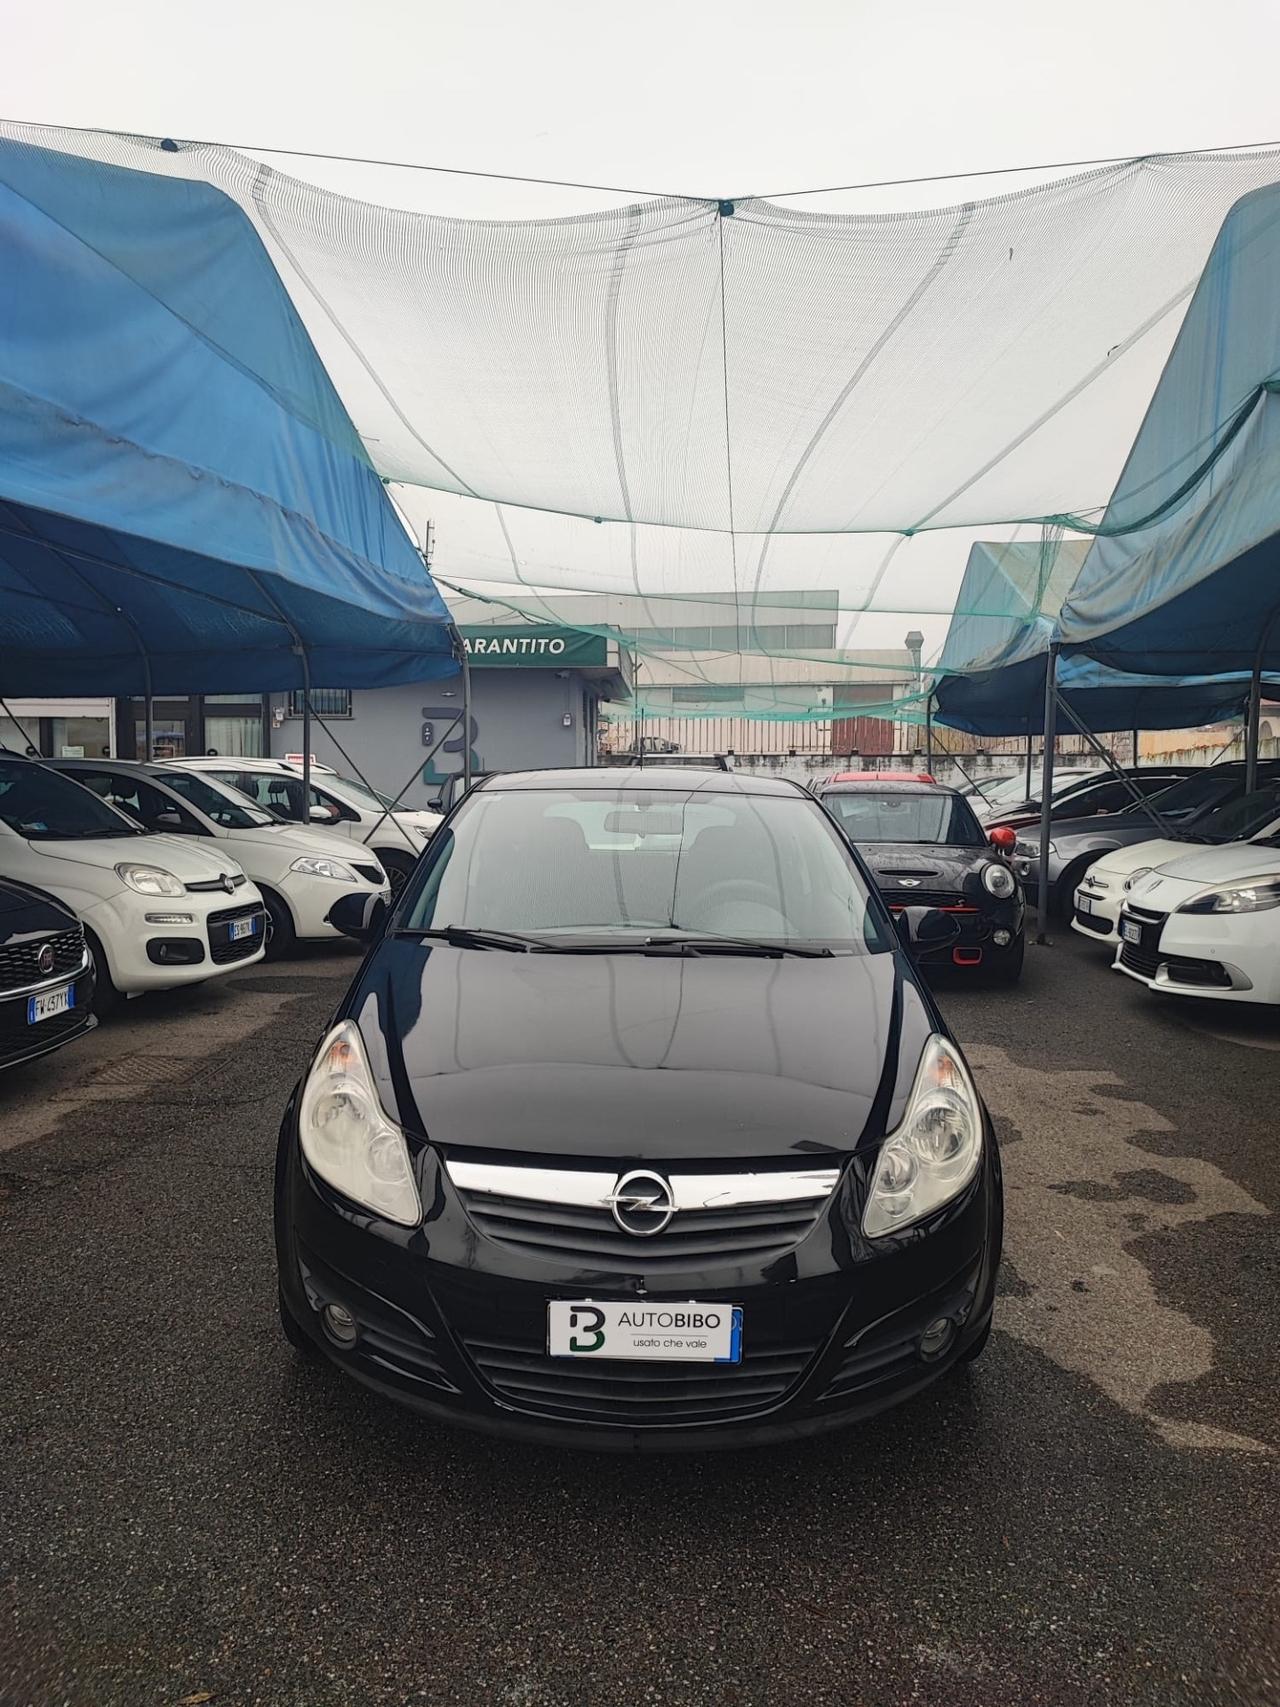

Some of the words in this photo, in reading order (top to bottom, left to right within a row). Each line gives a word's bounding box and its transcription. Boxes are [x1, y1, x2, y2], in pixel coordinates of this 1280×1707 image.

[462, 637, 565, 655] ARANTITO
[617, 1311, 721, 1329] AUTOBIBO
[632, 1337, 661, 1348] usato
[662, 1337, 684, 1349] che
[685, 1338, 708, 1349] vale
